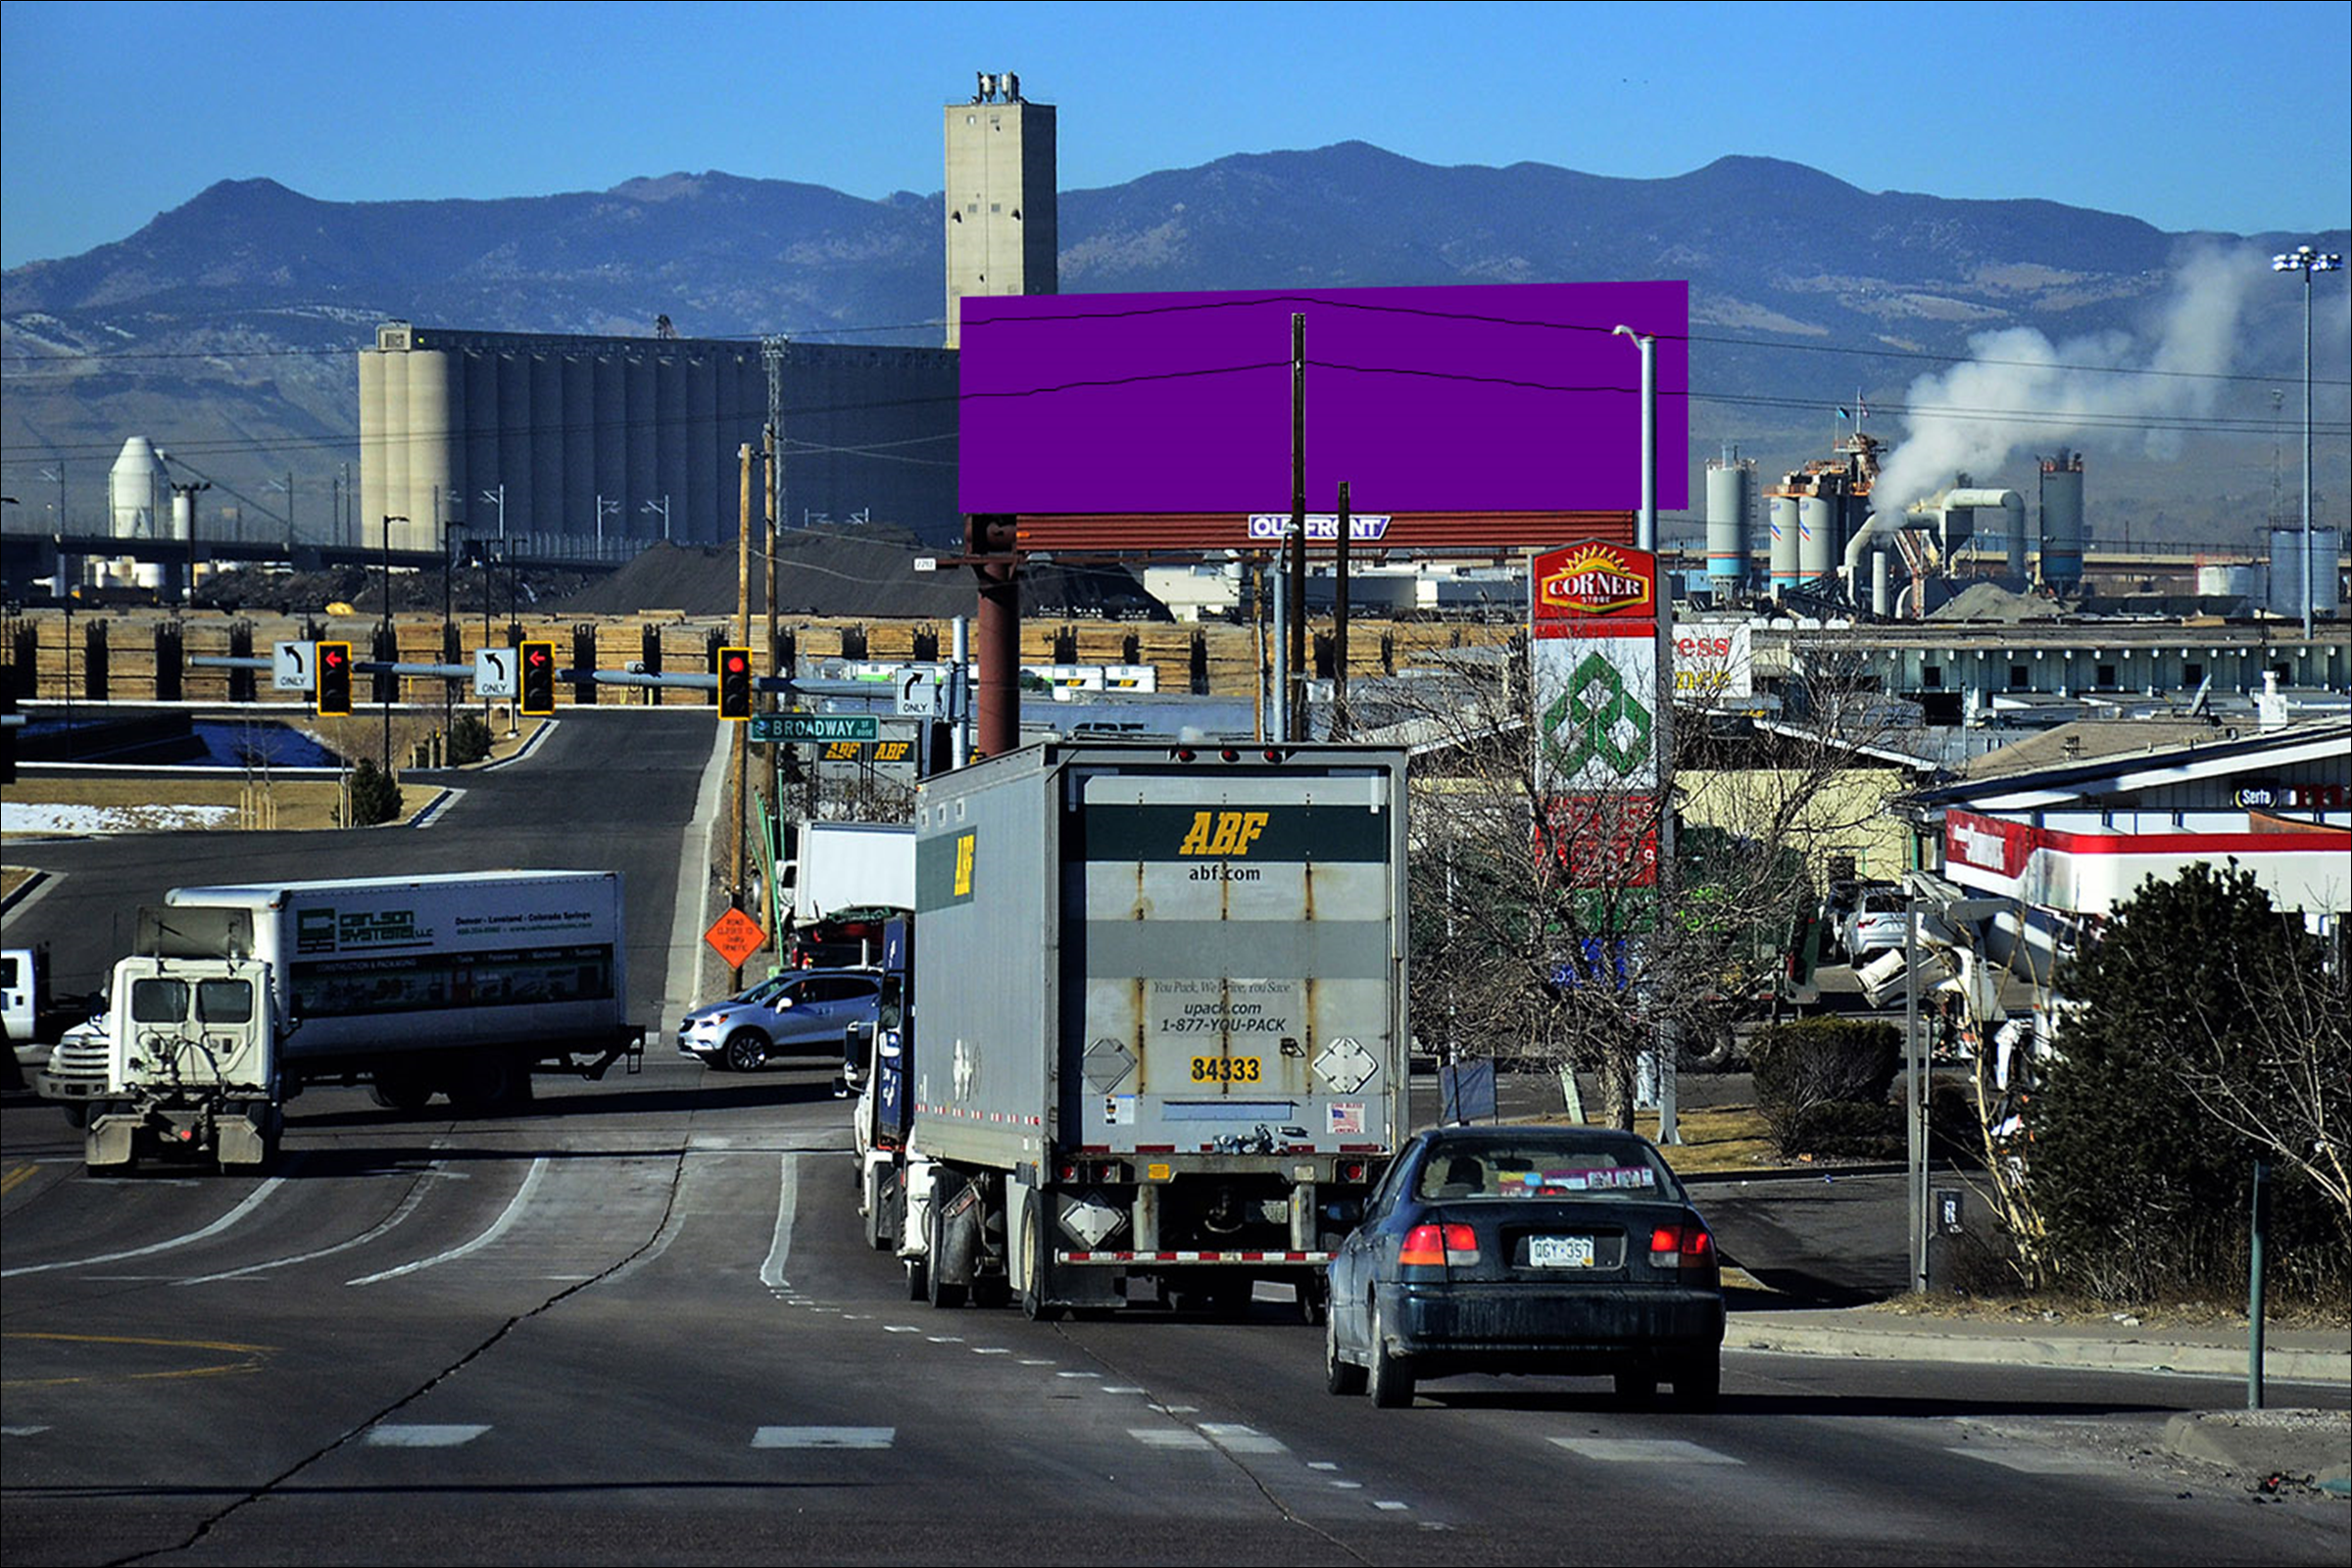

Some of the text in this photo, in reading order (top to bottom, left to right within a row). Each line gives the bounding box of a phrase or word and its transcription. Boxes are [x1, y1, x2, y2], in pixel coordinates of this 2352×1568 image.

[1253, 517, 1381, 536] OUFRNT
[1549, 571, 1640, 596] CORNER
[1669, 637, 1731, 657] ess
[280, 676, 305, 686] ONLY
[482, 683, 507, 693] ONLY
[904, 703, 927, 713] ONLY
[773, 720, 855, 736] BROADWAY
[825, 743, 860, 760] ABF
[874, 743, 908, 760] ABF
[2242, 789, 2271, 805] Serta
[1179, 811, 1269, 855] ABF
[955, 834, 974, 896] ABF
[1189, 864, 1260, 881] abf.com
[456, 916, 481, 925] Denver
[528, 912, 562, 921] Colorado
[564, 910, 591, 920] Springs
[1154, 981, 1172, 993] You
[1201, 981, 1216, 994] We
[1184, 1003, 1262, 1016] upack.com
[1161, 1018, 1287, 1032] 1-877-YOU-PACK
[1192, 1058, 1259, 1081] 84333
